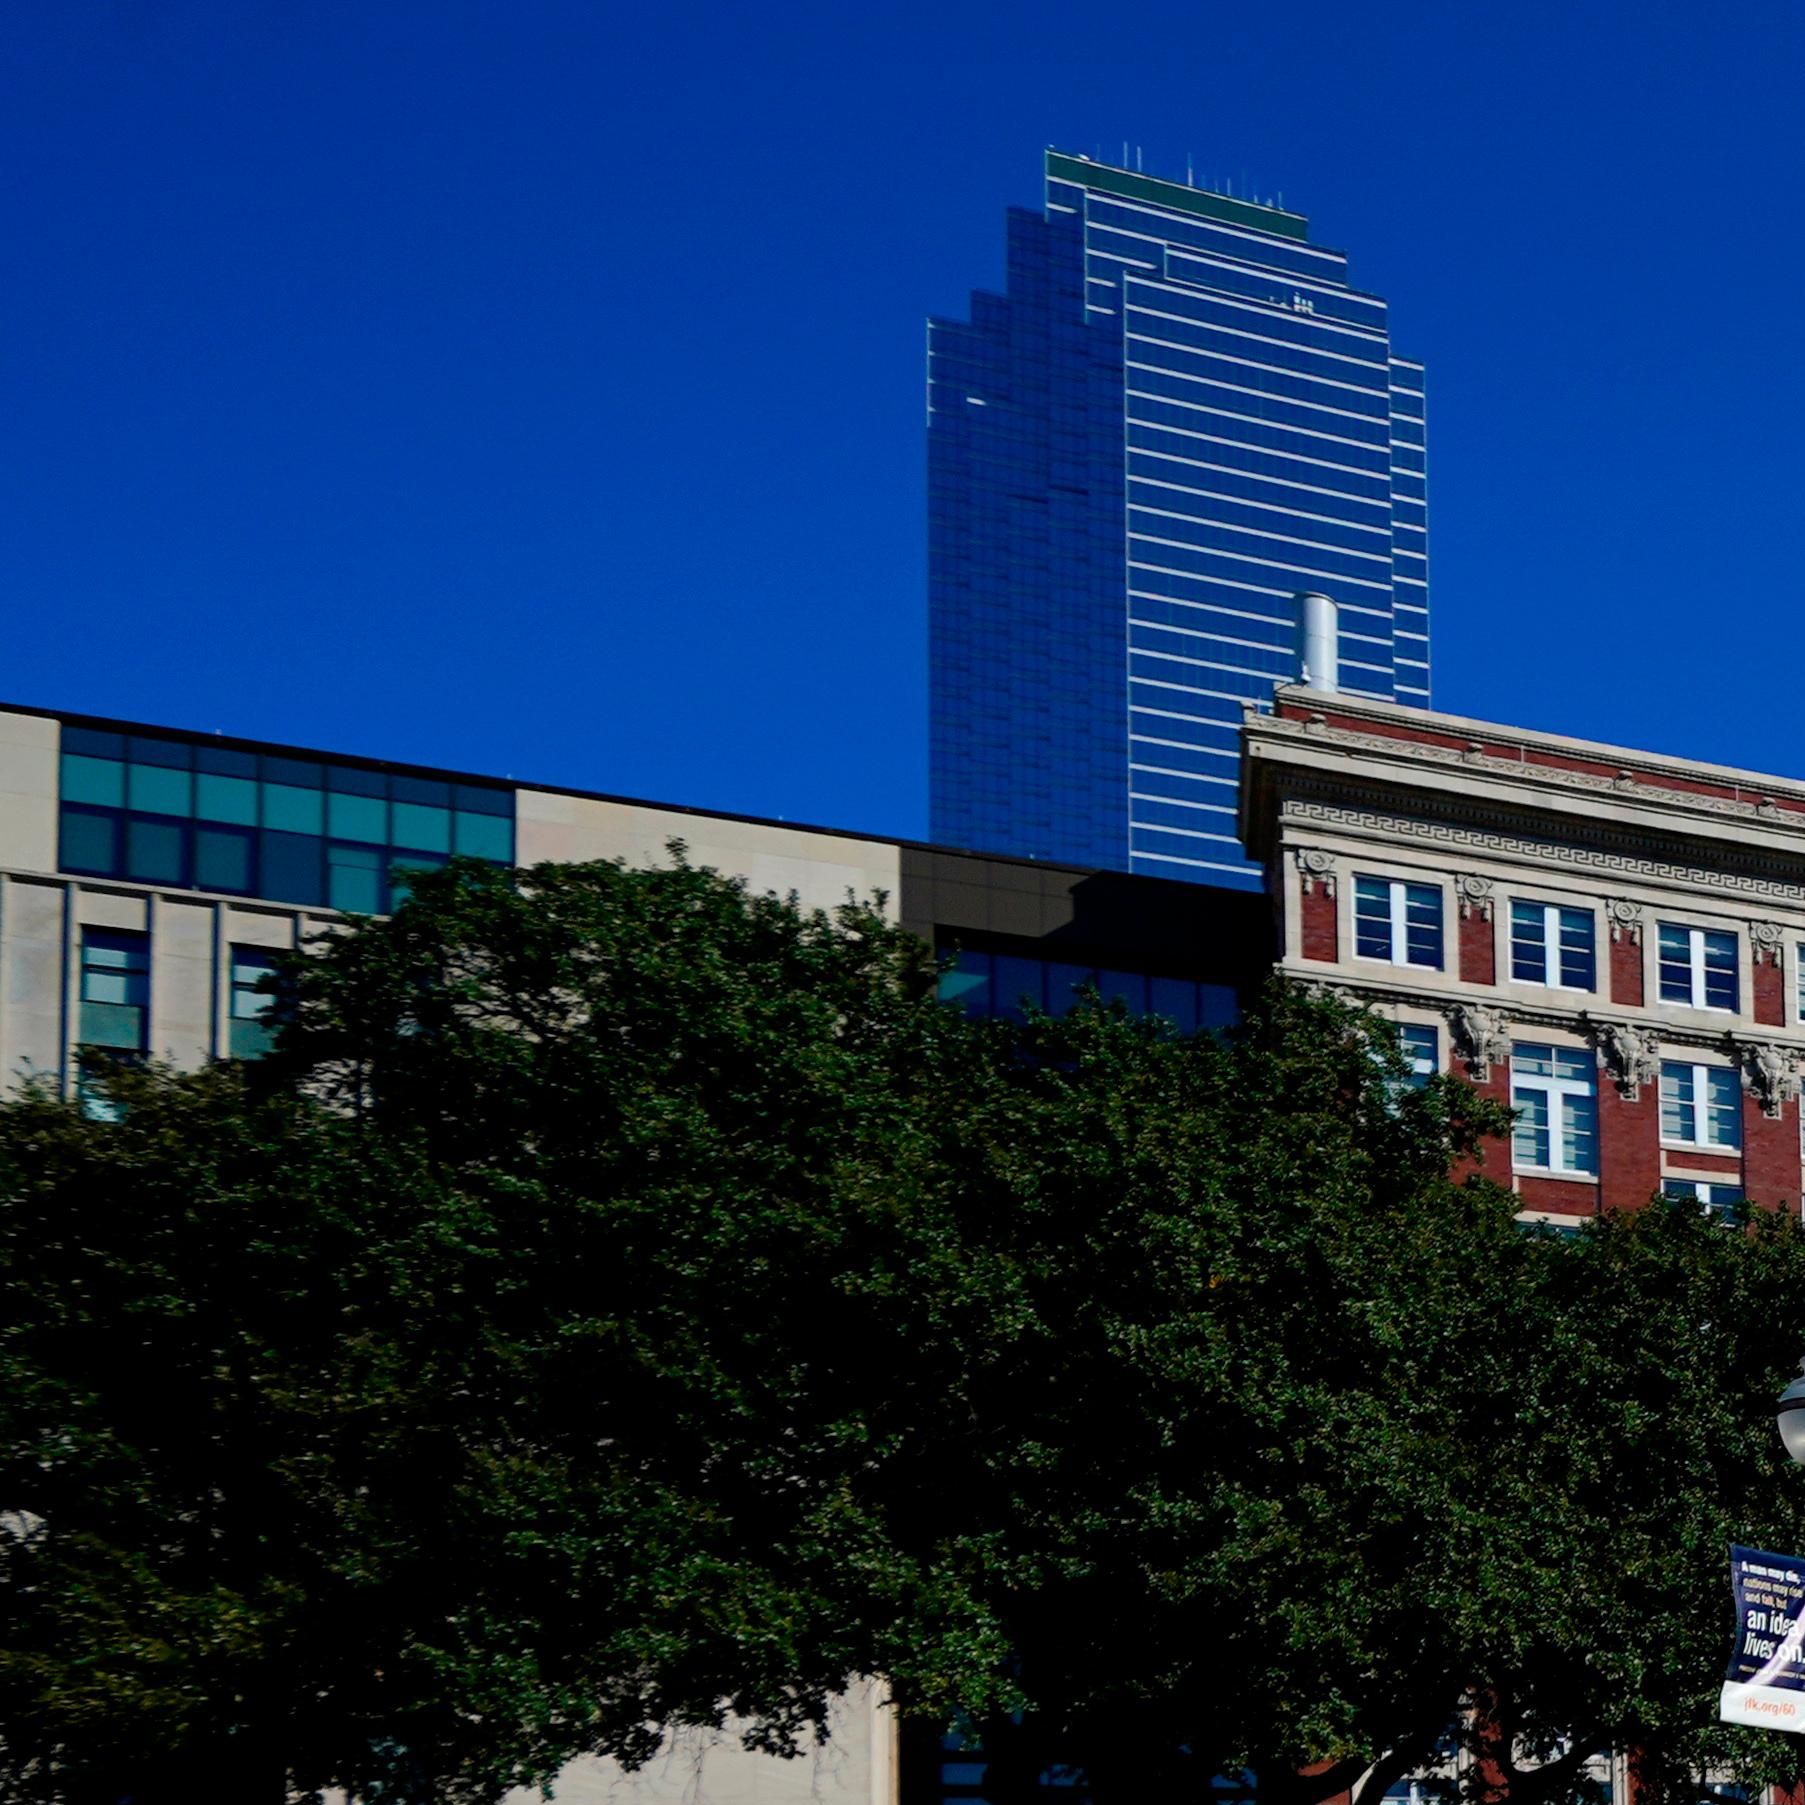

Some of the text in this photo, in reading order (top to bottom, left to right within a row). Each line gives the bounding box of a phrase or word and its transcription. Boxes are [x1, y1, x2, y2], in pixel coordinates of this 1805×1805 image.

[1741, 1560, 1749, 1572] A
[1747, 1609, 1799, 1637] an idea
[1743, 1631, 1776, 1659] lives
[1744, 1695, 1796, 1717] jfk.org/60
